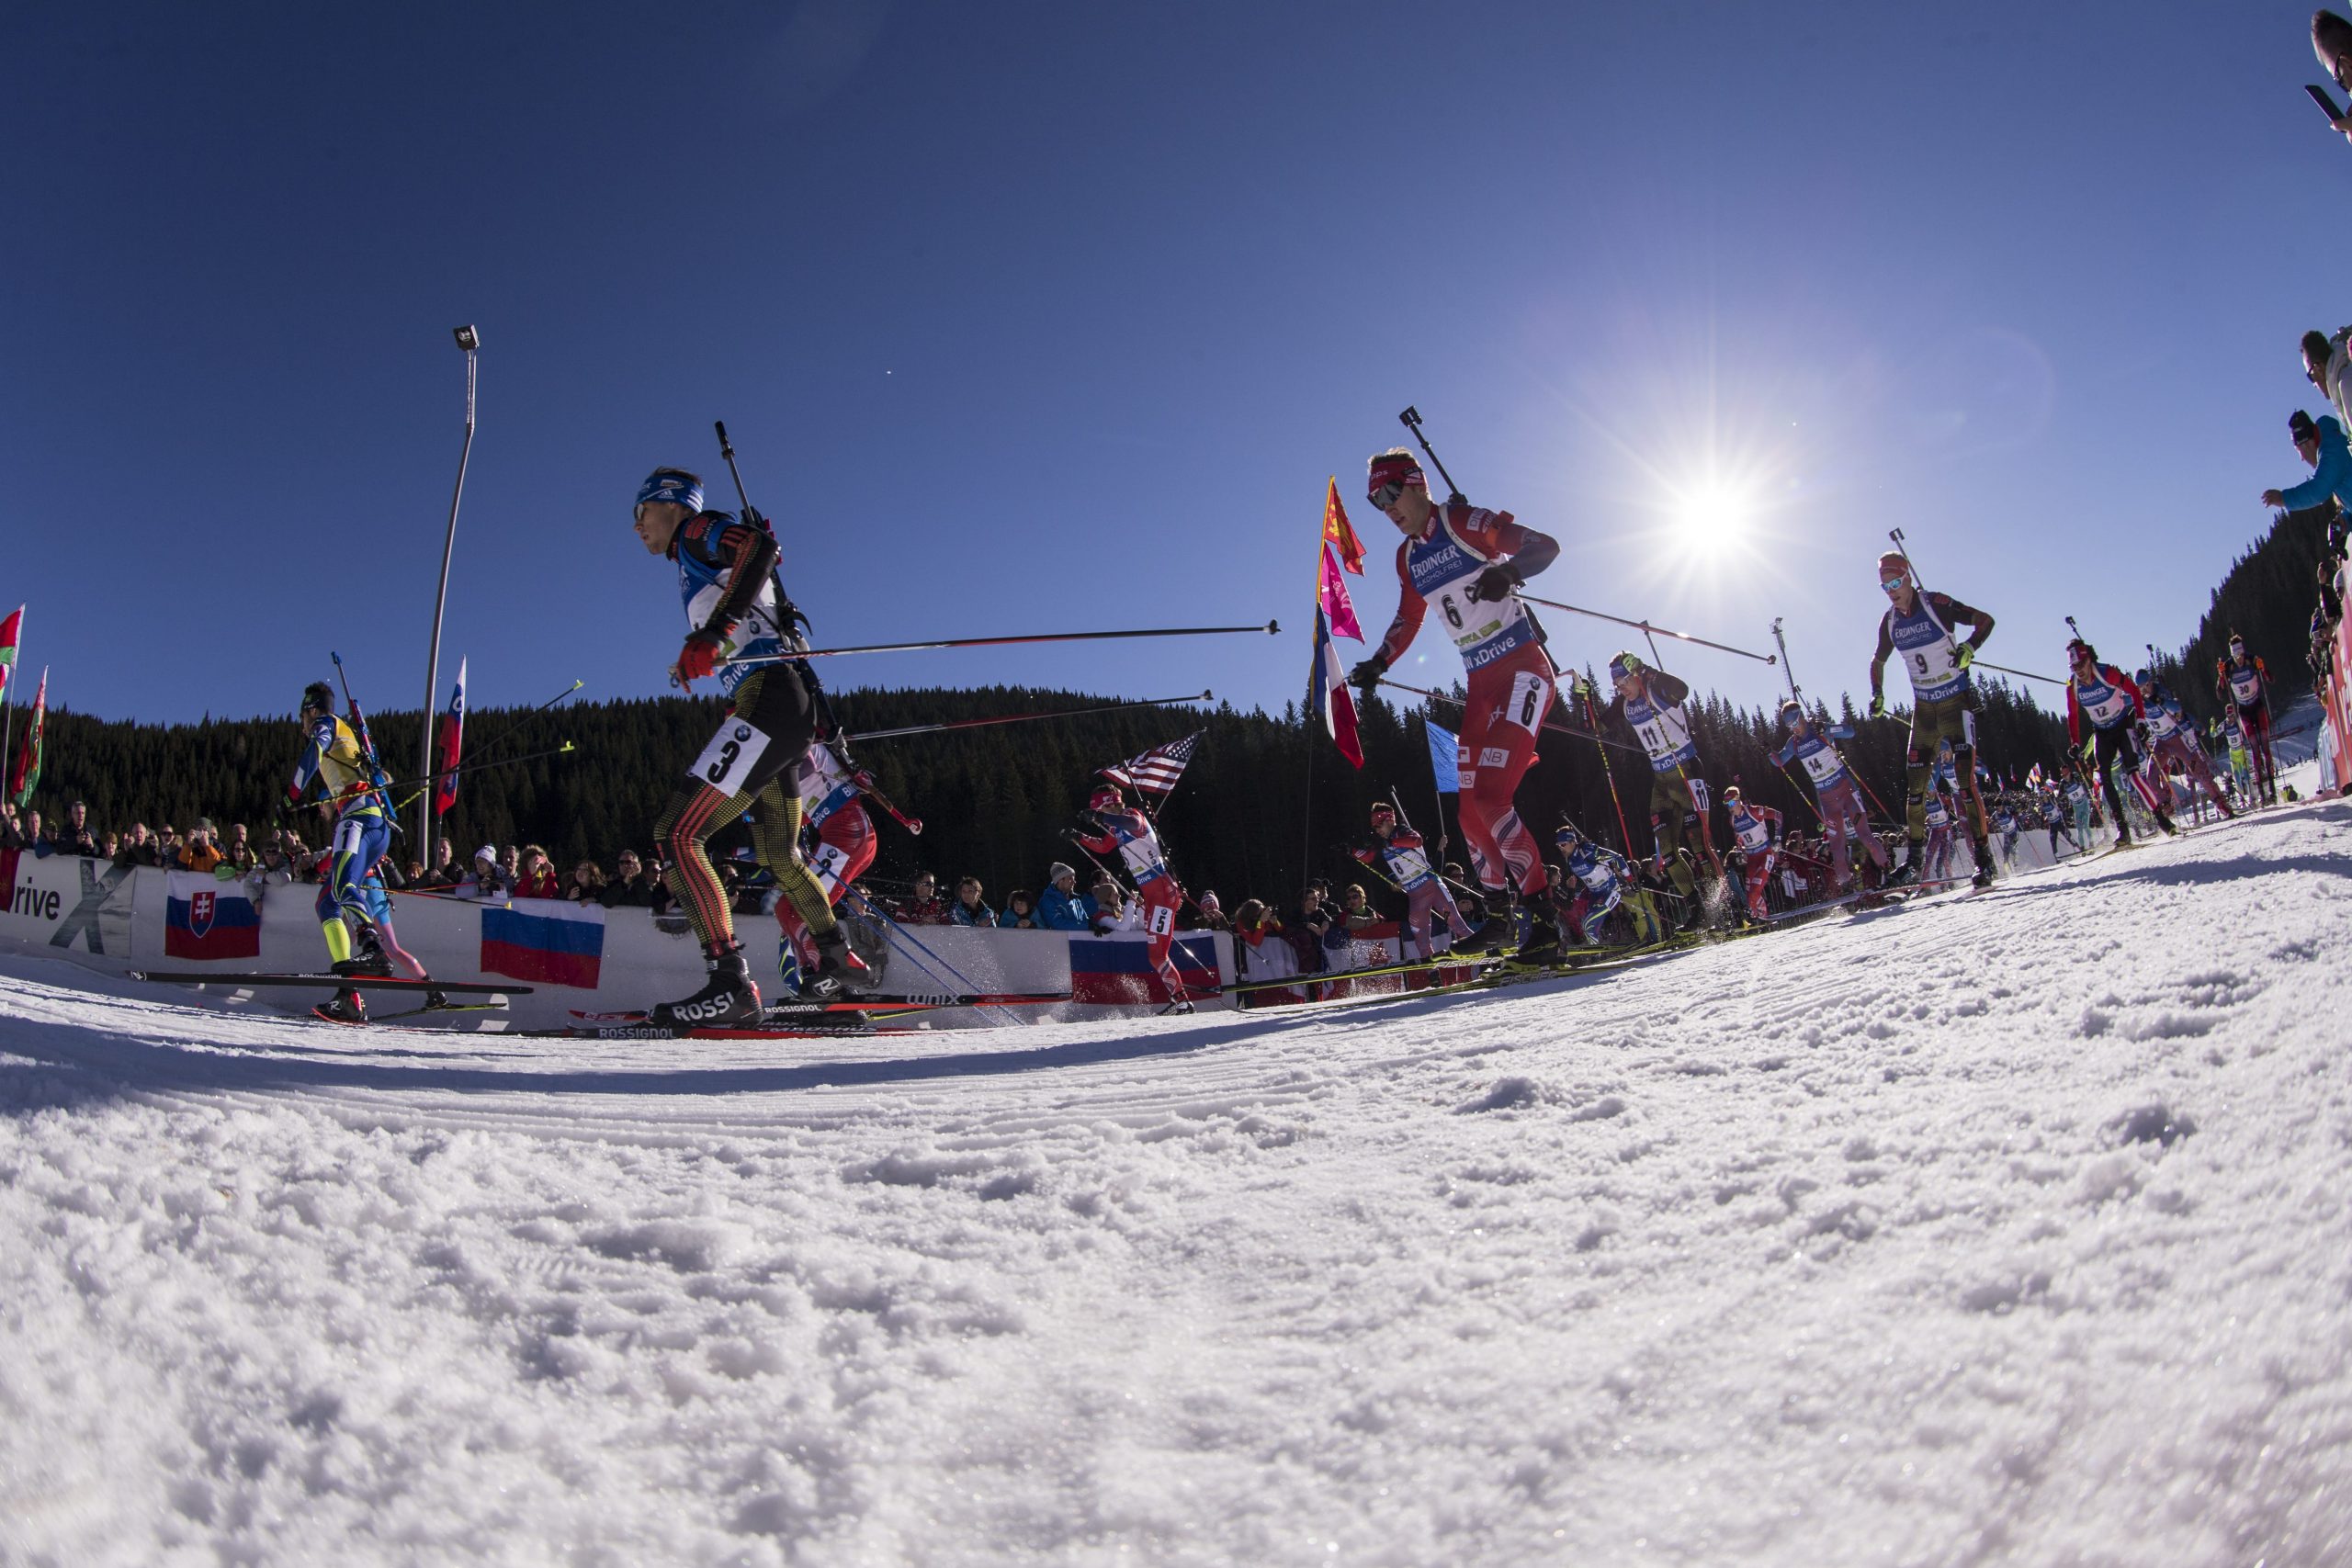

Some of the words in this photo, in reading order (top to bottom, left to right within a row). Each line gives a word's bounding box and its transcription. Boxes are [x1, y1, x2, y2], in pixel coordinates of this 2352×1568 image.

[1411, 545, 1461, 579] ERDINGER
[1416, 559, 1463, 588] ALKOHOLFREI
[1442, 594, 1464, 630] 6
[1895, 622, 1932, 638] ERDINGER
[1475, 637, 1516, 667] xDrive
[1916, 653, 1928, 674] 9
[1930, 683, 1959, 700] xDrive
[2079, 687, 2108, 700] ERDINGER
[2239, 685, 2250, 695] 30
[1521, 690, 1537, 727] 6
[2096, 705, 2109, 717] 12
[1643, 727, 1659, 747] 11
[707, 740, 741, 784] 3
[1808, 757, 1823, 773] 14
[1695, 788, 1709, 809] 11
[342, 829, 350, 851] 1
[1744, 832, 1754, 844] 13
[1393, 862, 1404, 875] 8
[1156, 919, 1167, 933] 5
[1433, 955, 1501, 970] FISCHER
[1499, 970, 1559, 987] FISCHER
[672, 991, 735, 1021] ROSSI
[764, 1003, 822, 1014] ROSSIGNOL
[599, 1027, 676, 1040] ROSSIGNOL
